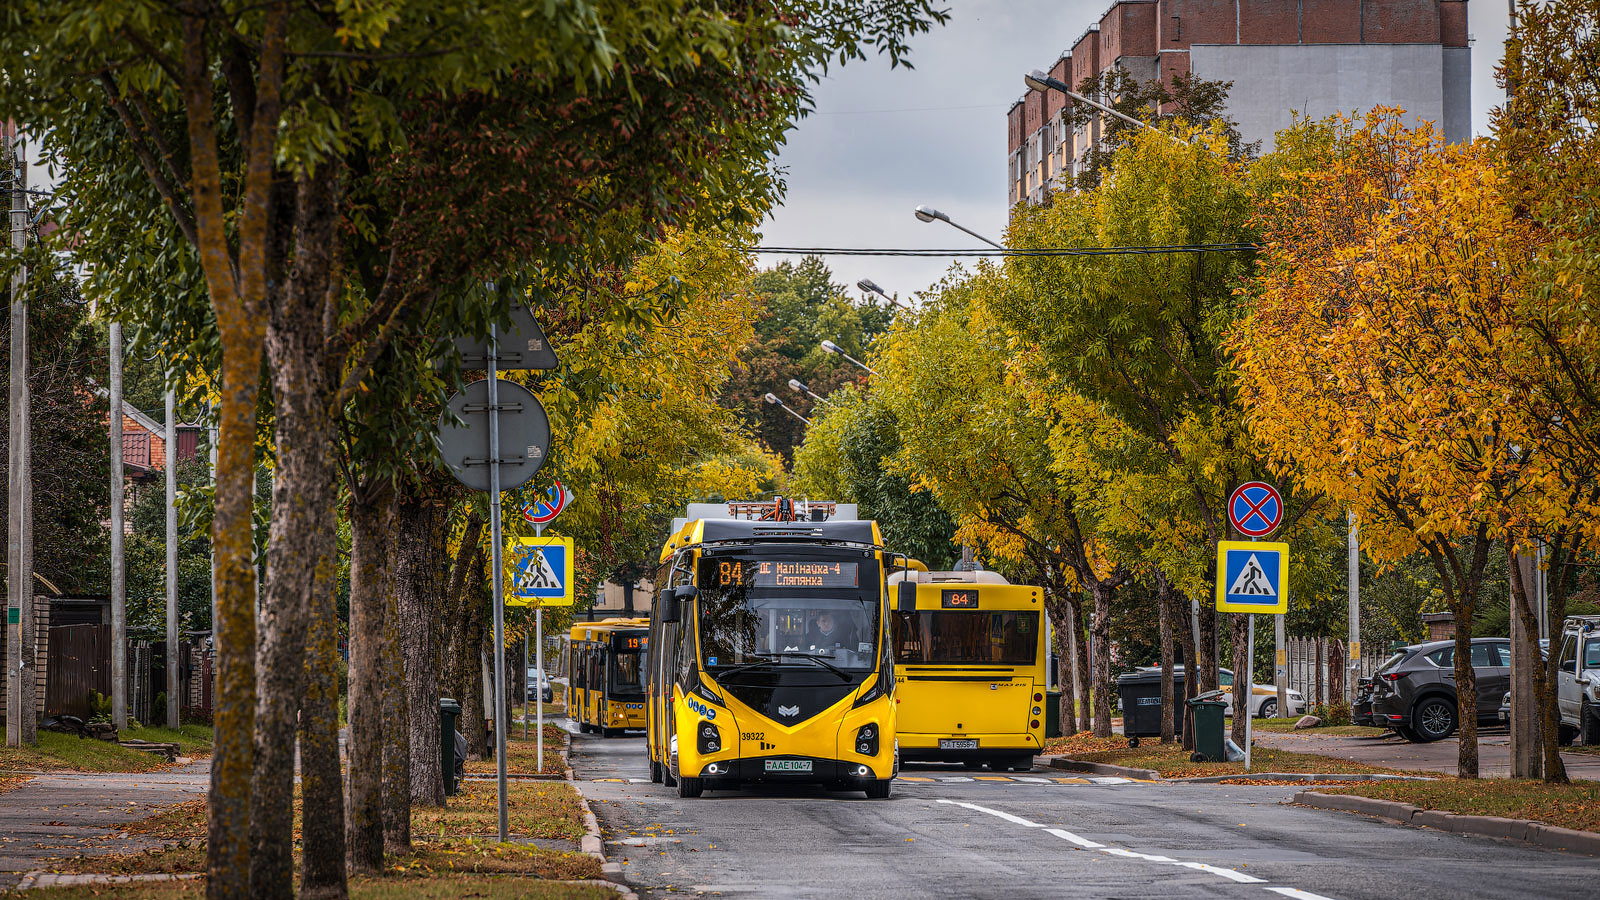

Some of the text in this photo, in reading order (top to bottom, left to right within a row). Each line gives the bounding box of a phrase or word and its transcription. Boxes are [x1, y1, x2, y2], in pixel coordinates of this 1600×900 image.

[776, 561, 840, 574] Малінаўка-4
[720, 562, 742, 586] 84
[776, 574, 823, 586] Сляпянка
[952, 594, 968, 605] 84
[628, 637, 639, 648] 19
[741, 732, 765, 741] 39322
[772, 761, 790, 769] AAE
[791, 761, 811, 770] 104-7
